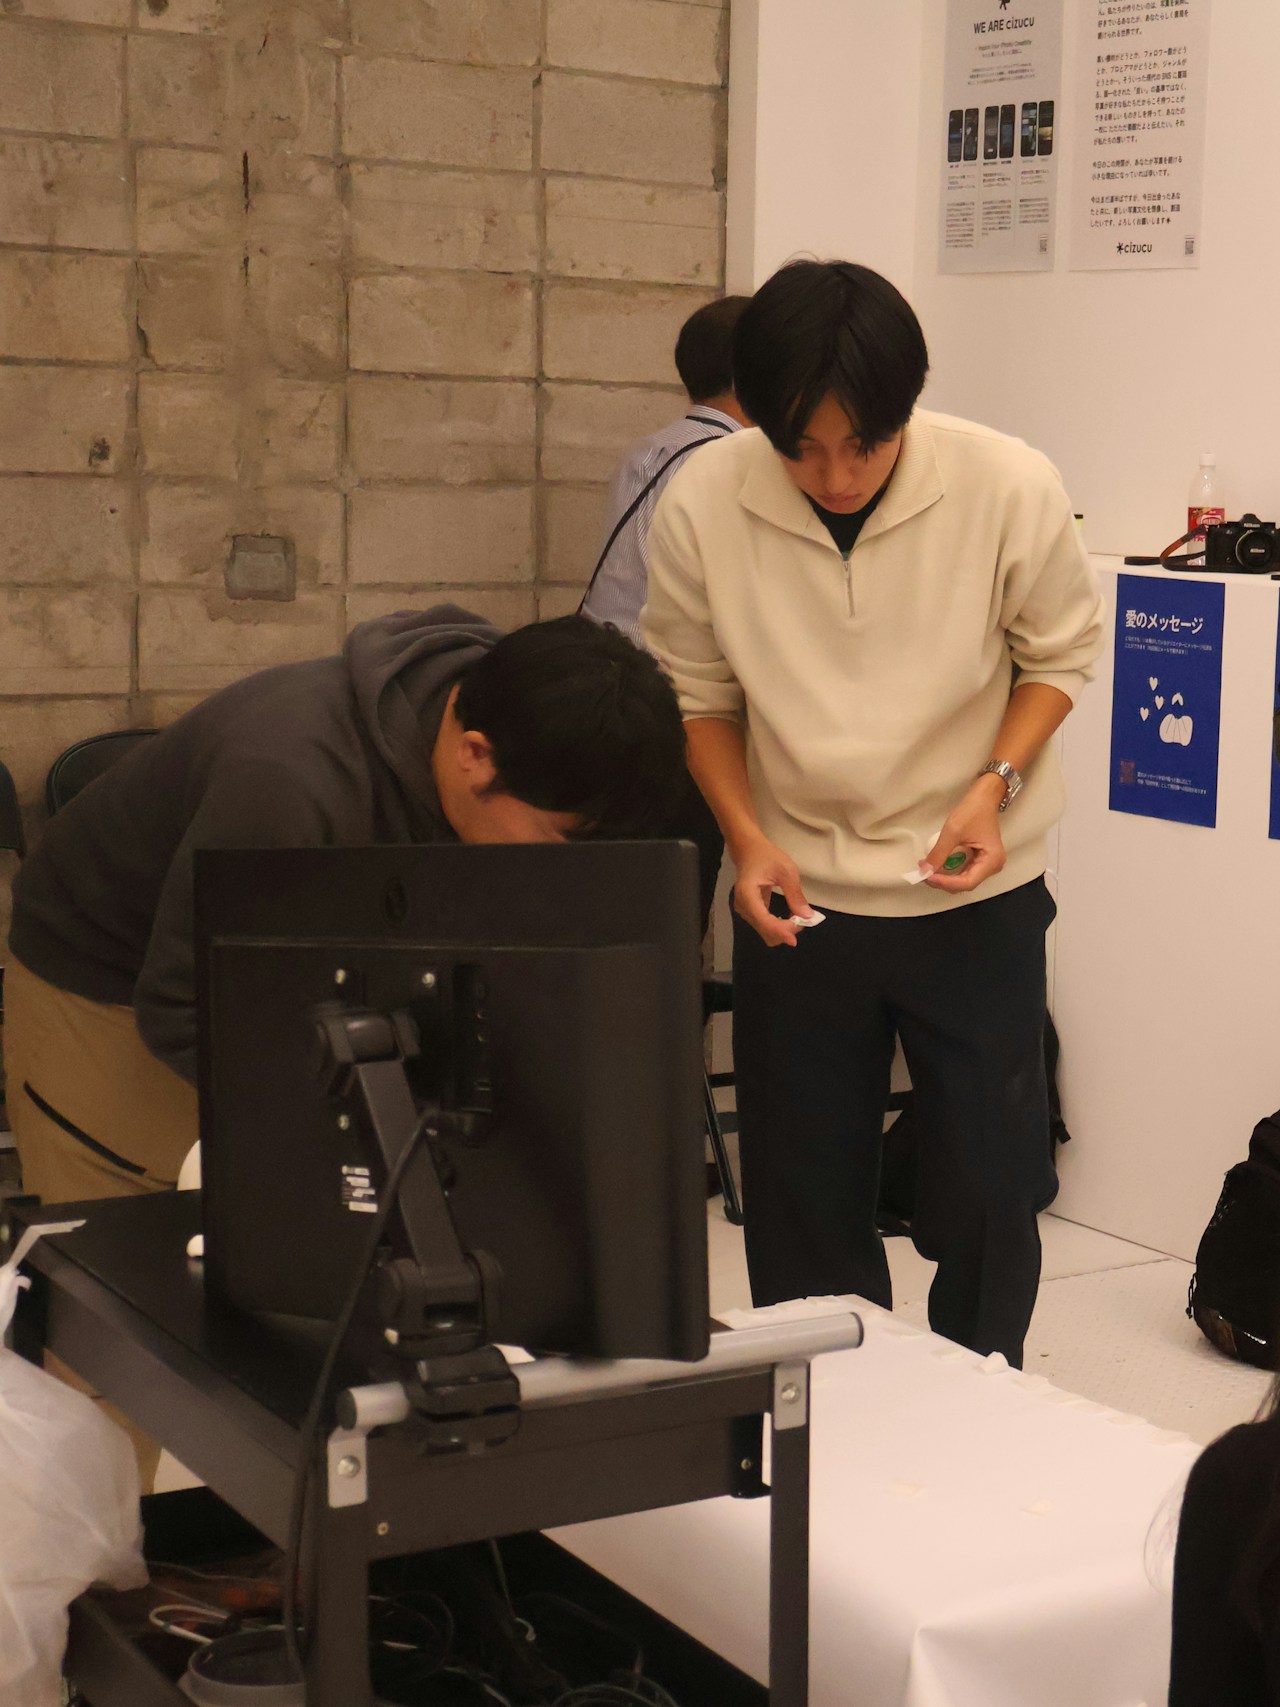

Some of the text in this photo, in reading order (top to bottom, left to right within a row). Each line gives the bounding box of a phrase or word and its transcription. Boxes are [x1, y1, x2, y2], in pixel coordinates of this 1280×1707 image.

[974, 17, 1035, 34] WE ARE cizucu
[1124, 241, 1153, 254] cizucu
[1125, 609, 1204, 635] 愛のメッセージ
